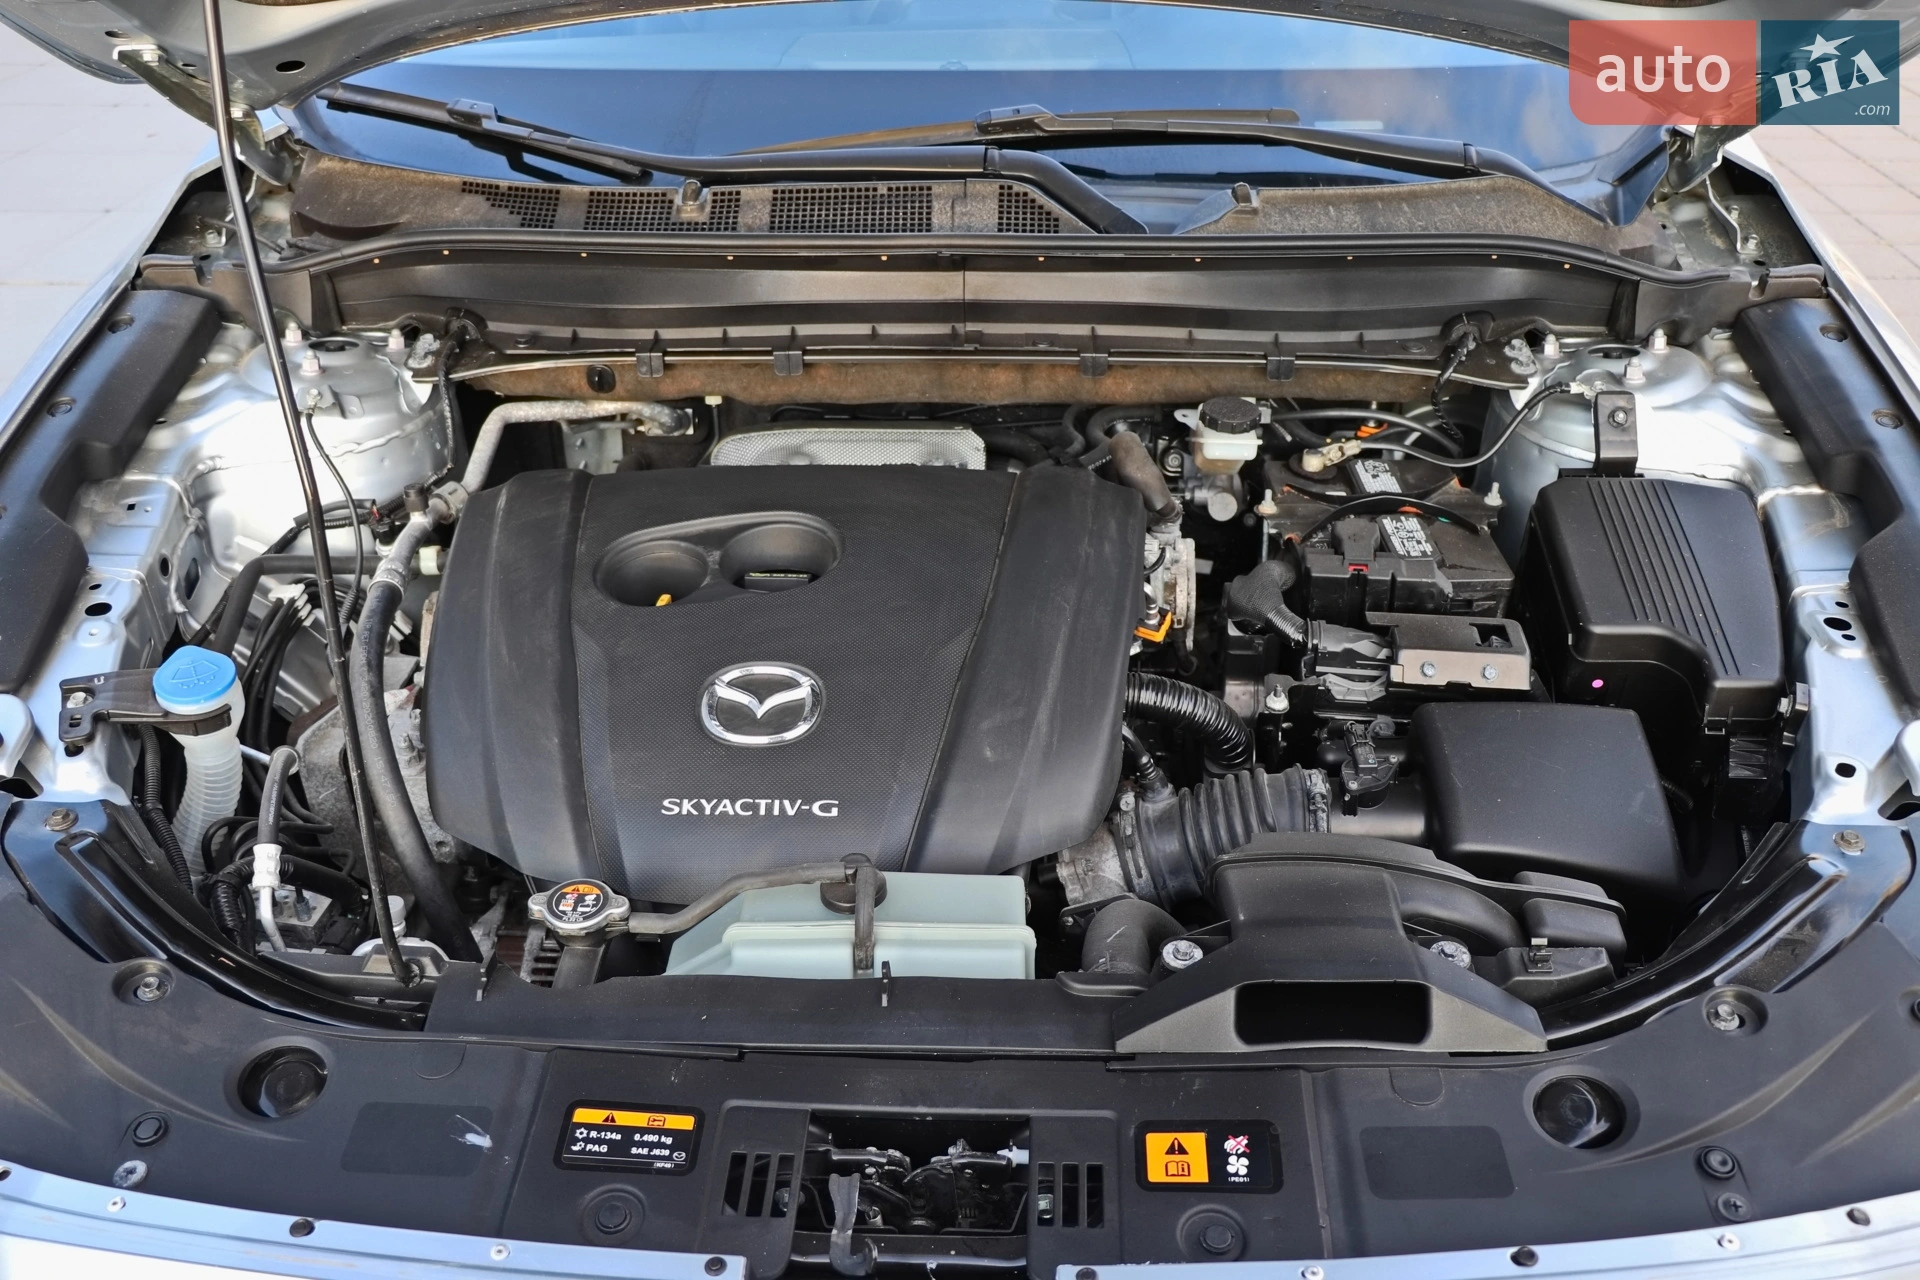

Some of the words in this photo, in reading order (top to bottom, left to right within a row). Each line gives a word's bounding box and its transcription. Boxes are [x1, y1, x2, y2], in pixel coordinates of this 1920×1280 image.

[660, 798, 840, 817] SKYACTIV-G
[589, 1130, 622, 1140] R-134a
[634, 1133, 659, 1143] 0.490
[660, 1135, 673, 1144] kg
[586, 1143, 608, 1152] PAG
[630, 1147, 649, 1155] SAE
